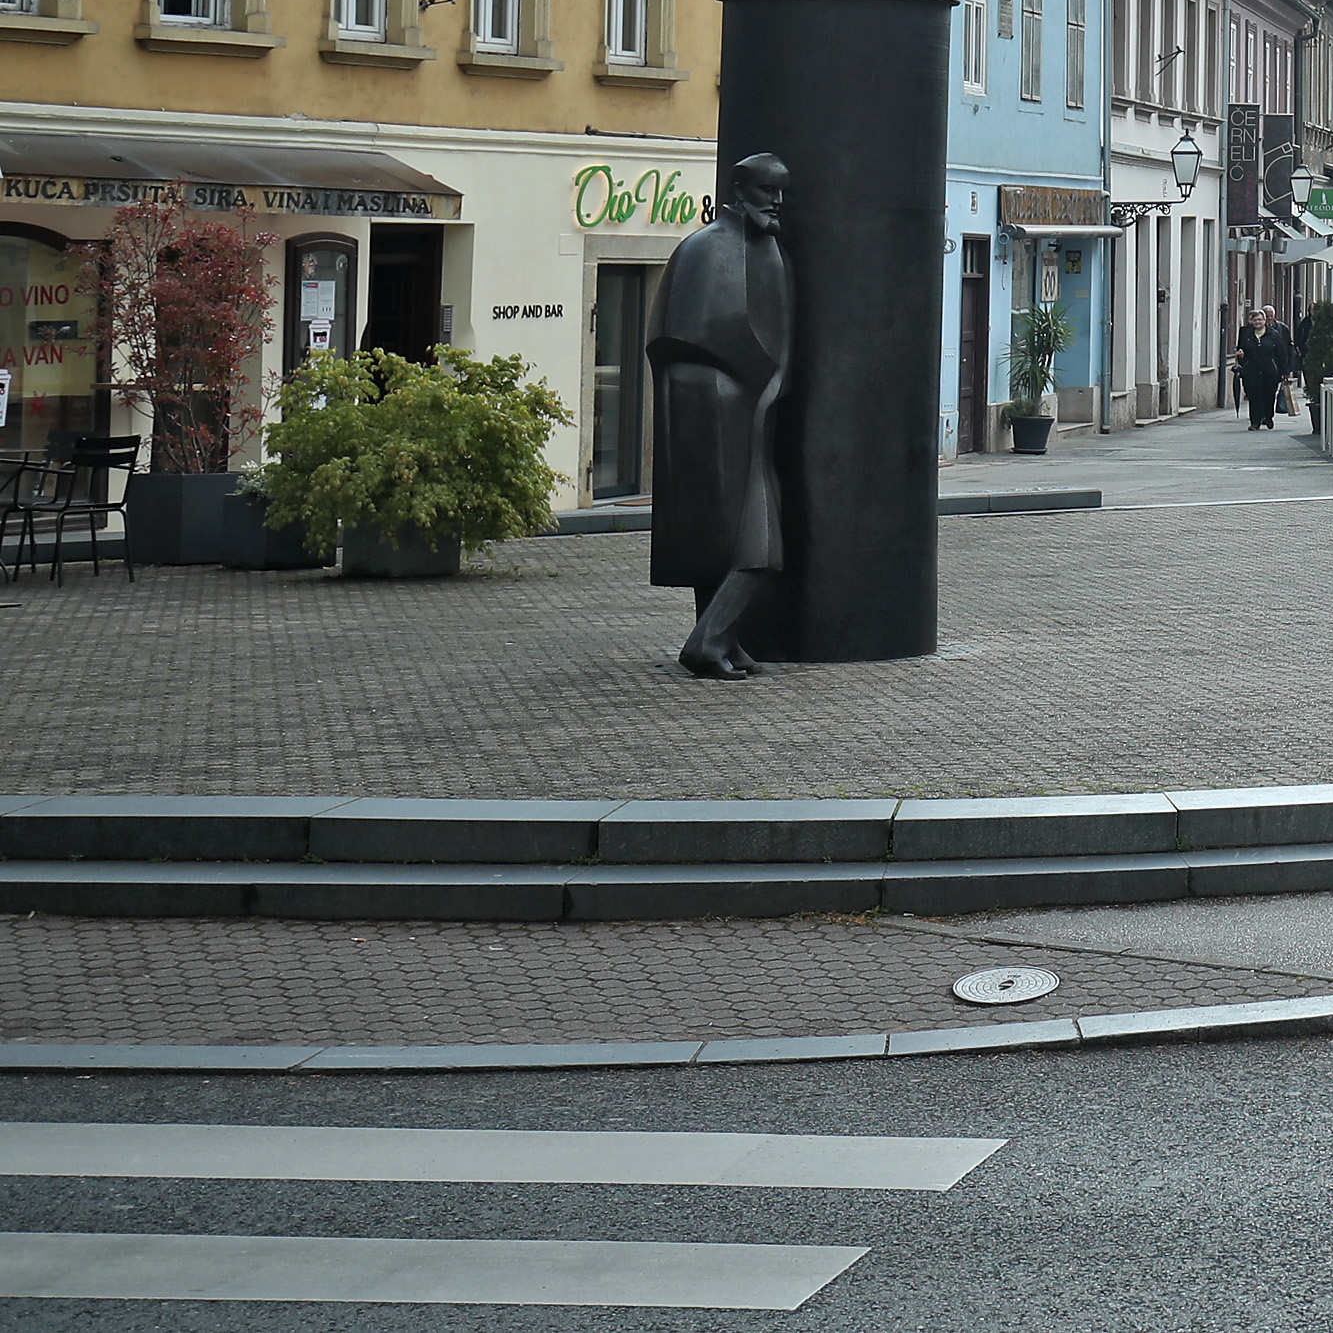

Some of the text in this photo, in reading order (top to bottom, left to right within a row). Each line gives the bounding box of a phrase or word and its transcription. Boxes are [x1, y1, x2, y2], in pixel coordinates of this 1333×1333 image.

[1230, 107, 1256, 126] ČE
[1230, 128, 1256, 144] RN
[1230, 146, 1256, 162] ELI
[1229, 162, 1244, 181] Ć
[4, 176, 76, 200] KUĆA
[194, 187, 255, 209] SIRA,
[263, 190, 317, 210] VINA
[322, 193, 329, 210] I
[337, 194, 431, 214] MASLINA
[20, 284, 70, 306] VINO
[492, 304, 564, 320] SHOP AND BAR
[22, 344, 63, 366] VAN
